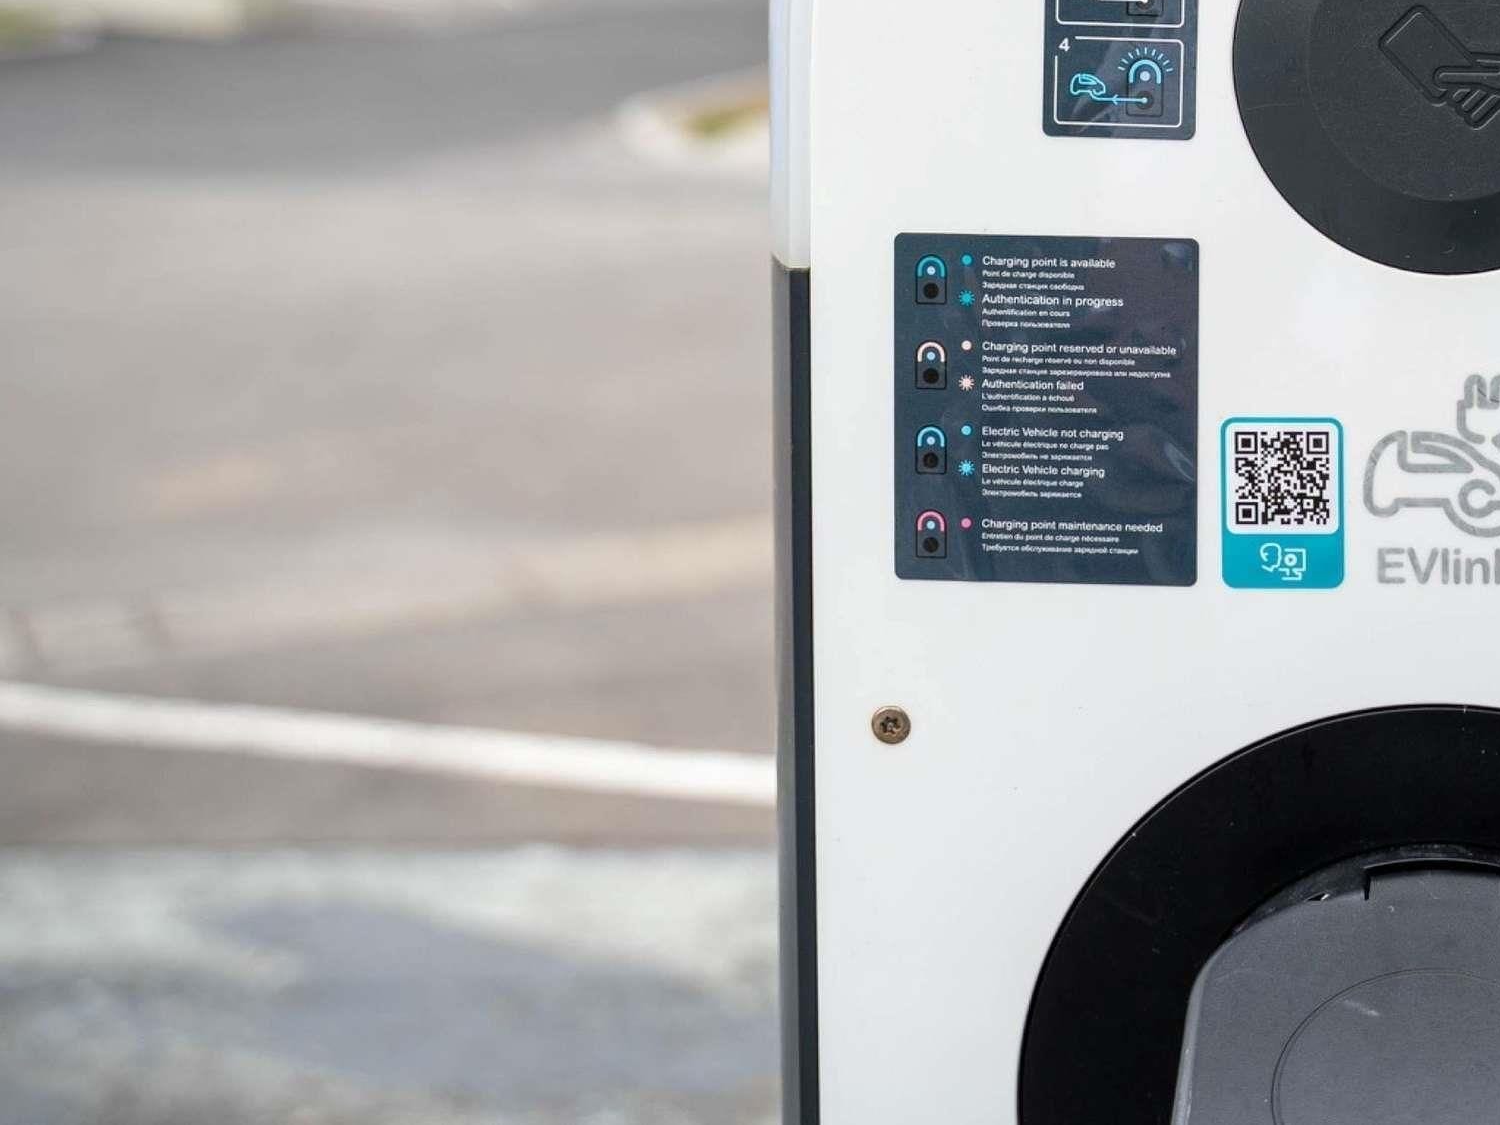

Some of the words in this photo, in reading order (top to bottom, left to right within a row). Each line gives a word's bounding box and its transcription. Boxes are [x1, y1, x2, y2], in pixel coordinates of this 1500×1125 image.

[1059, 38, 1070, 51] 4
[983, 256, 1029, 268] Charging
[1032, 258, 1057, 268] point
[1060, 257, 1068, 268] is
[1071, 258, 1115, 269] available
[982, 294, 1059, 305] Authentication
[1063, 297, 1072, 306] in
[1076, 298, 1123, 308] progress
[982, 341, 1028, 354] Charging
[1032, 344, 1056, 353] point
[1059, 344, 1104, 354] reserved
[1106, 346, 1116, 354] or
[1119, 346, 1176, 355] unavailable
[982, 379, 1053, 390] Authentication
[1057, 380, 1084, 391] failed
[982, 426, 1019, 436] Electric
[1022, 427, 1058, 438] Vehicle
[1061, 429, 1077, 438] not
[1079, 430, 1123, 441] charging
[982, 463, 1019, 474] Electric
[1022, 464, 1058, 475] Vehicle
[1061, 467, 1105, 478] charging
[982, 519, 1028, 531] Charging
[1031, 520, 1055, 531] point
[1058, 521, 1122, 532] maintenance
[1125, 523, 1162, 533] needed
